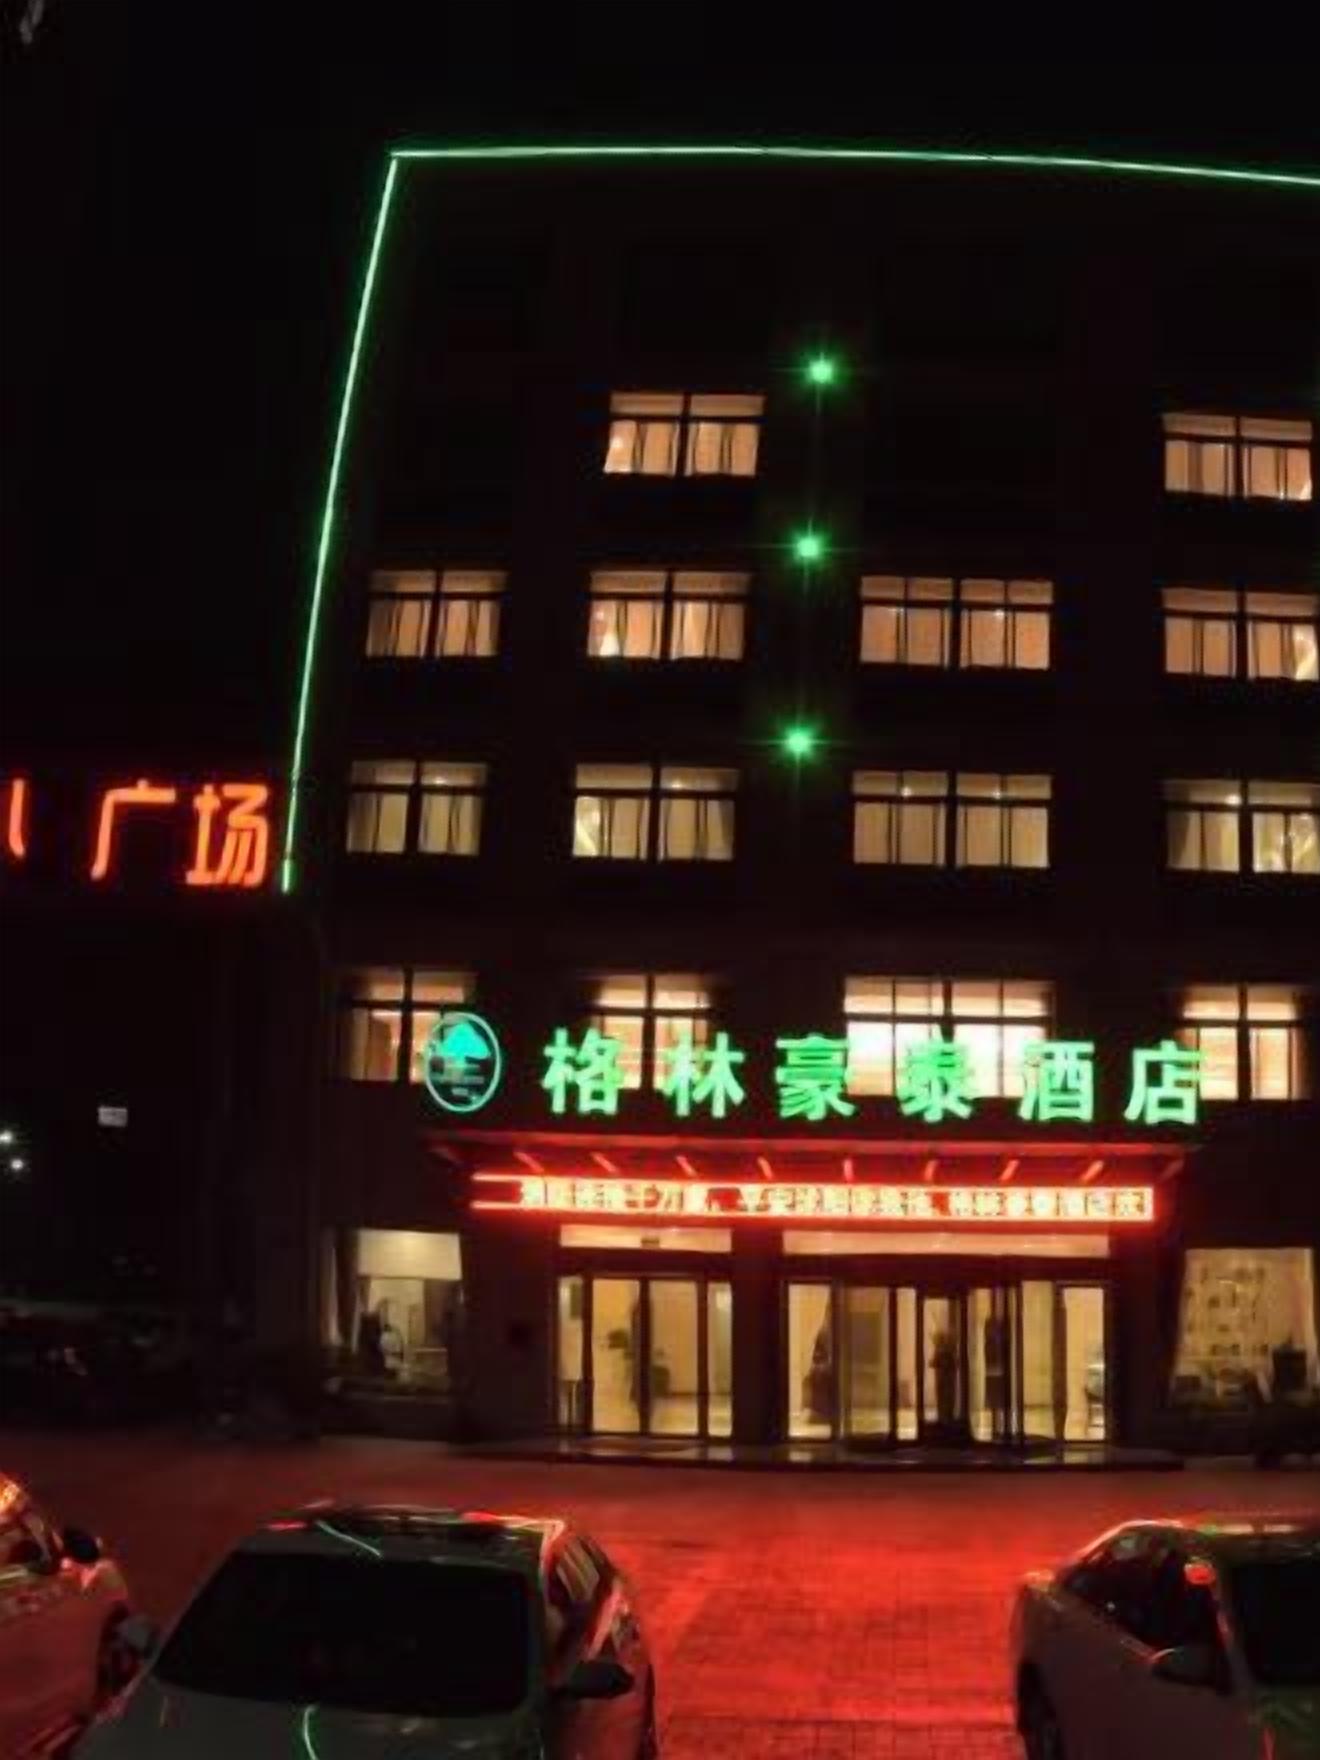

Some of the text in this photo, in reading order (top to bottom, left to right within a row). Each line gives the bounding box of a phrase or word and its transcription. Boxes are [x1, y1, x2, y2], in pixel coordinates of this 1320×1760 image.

[7, 778, 269, 887] 广场
[543, 1027, 1203, 1123] 格林豪泰酒店
